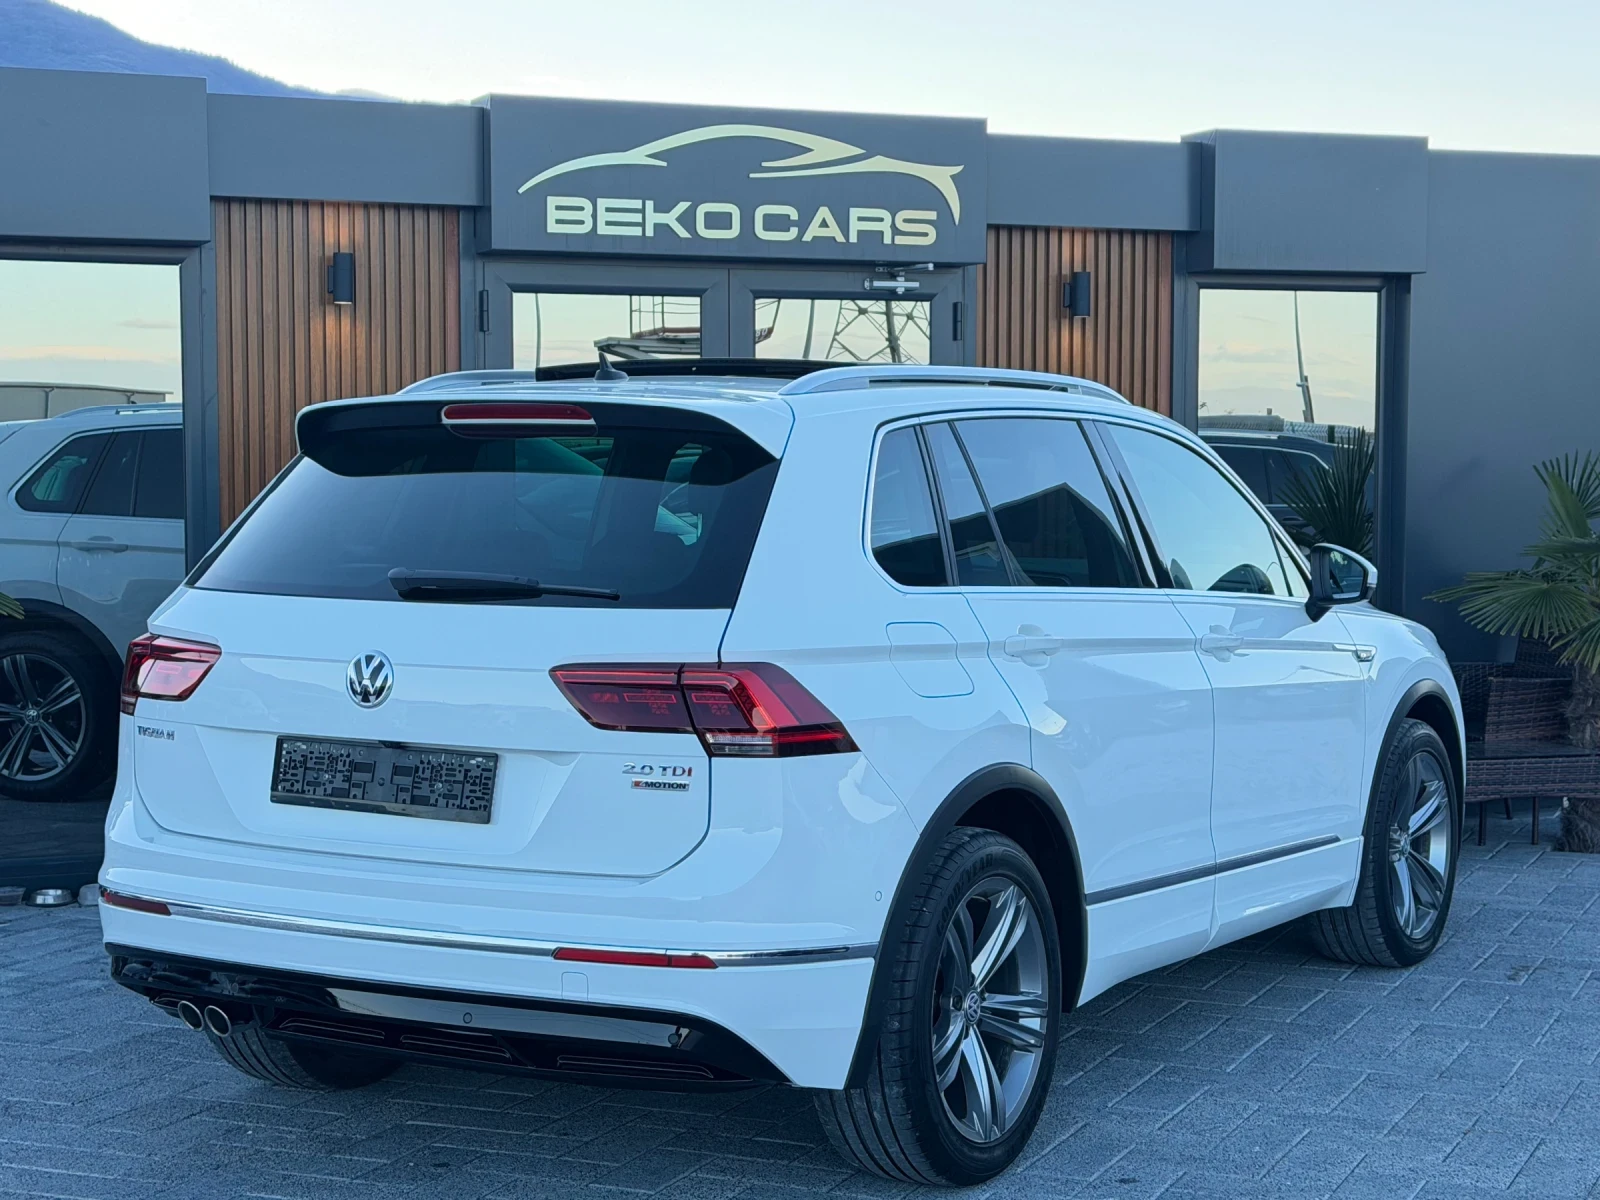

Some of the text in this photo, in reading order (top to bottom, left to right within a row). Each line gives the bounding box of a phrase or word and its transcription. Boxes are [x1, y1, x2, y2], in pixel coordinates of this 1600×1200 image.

[546, 195, 938, 246] BEKO CARS
[658, 765, 693, 777] TDI
